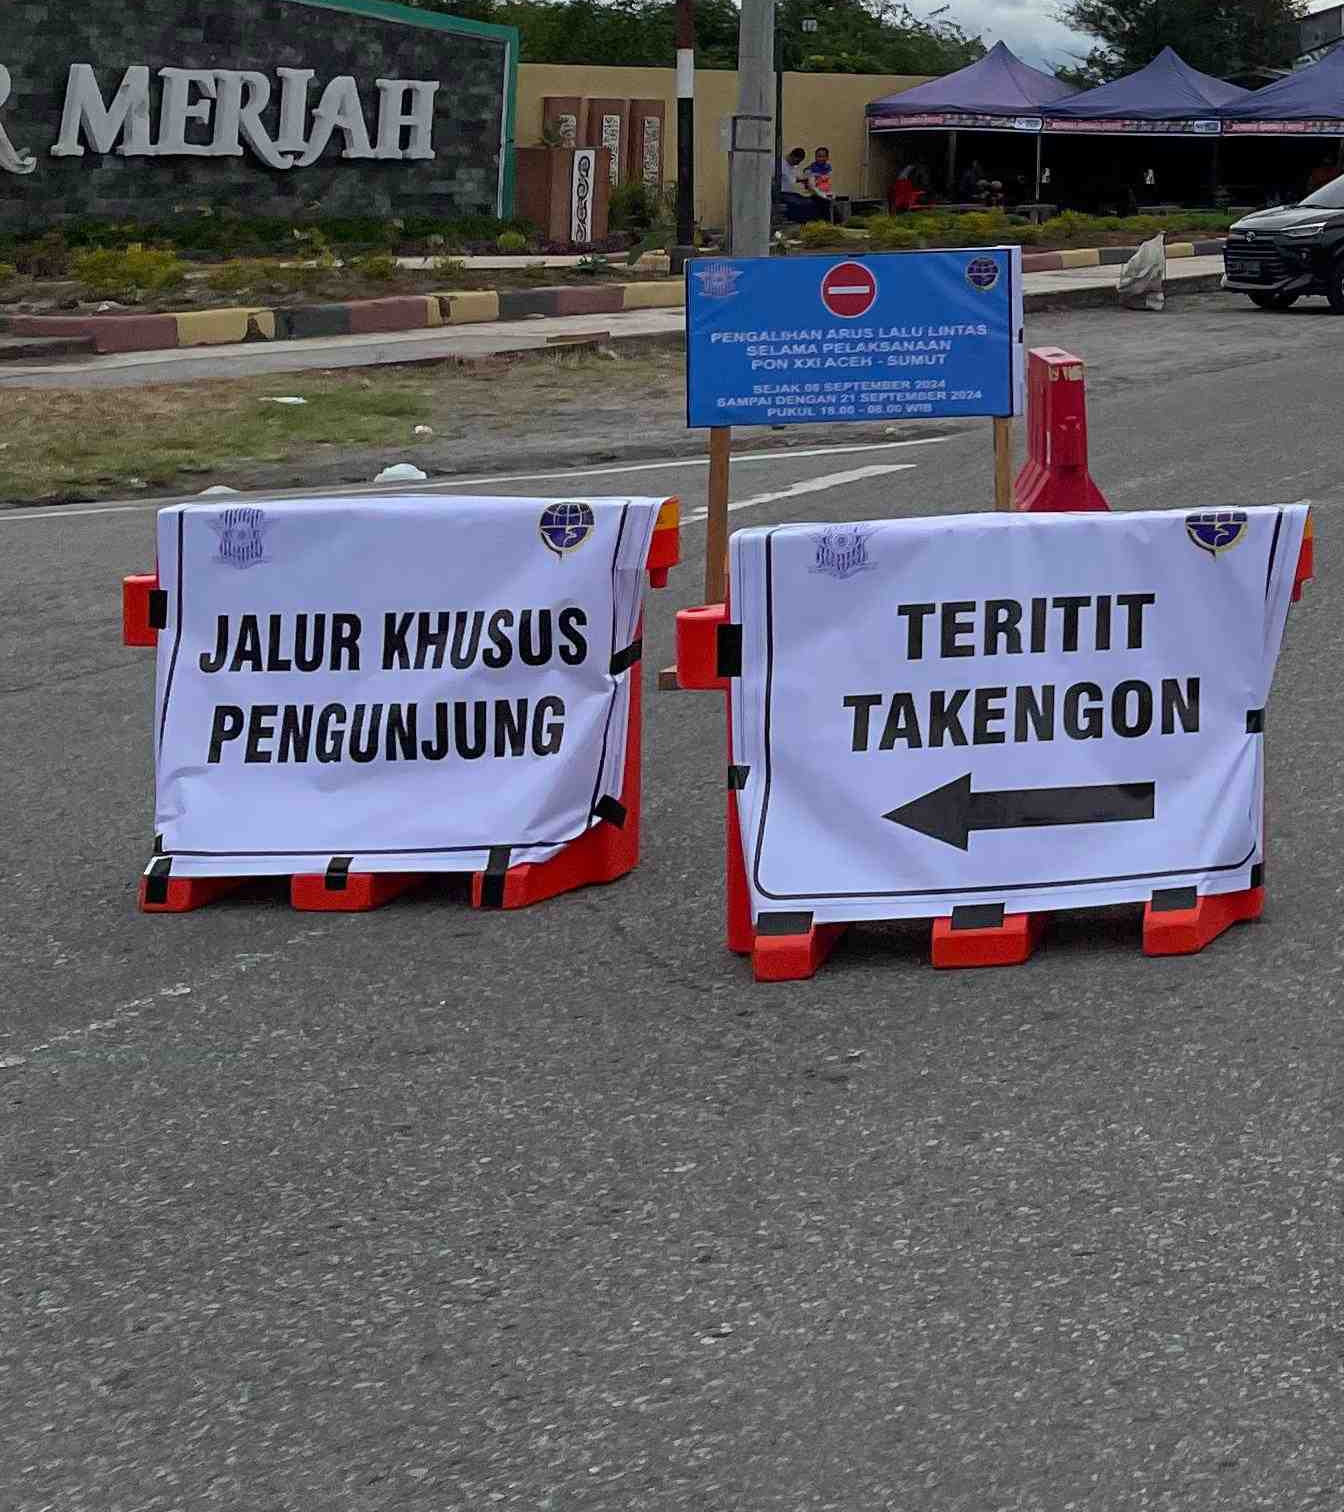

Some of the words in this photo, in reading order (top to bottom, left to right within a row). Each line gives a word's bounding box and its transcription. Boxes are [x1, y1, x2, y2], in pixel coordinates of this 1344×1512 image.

[50, 63, 440, 170] MERIAH
[711, 329, 822, 343] PENGALIHAN
[827, 327, 873, 339] ARUS
[879, 326, 922, 338] LALU
[928, 324, 988, 337] LINTAS
[746, 343, 818, 356] SELAMA
[823, 340, 952, 354] PELAKSANAAN
[752, 359, 788, 370] PON
[793, 357, 820, 368] XXI
[824, 356, 873, 368] ACEH
[887, 354, 947, 366] SUMUT
[753, 384, 801, 394] SEJAK
[823, 380, 912, 392] SEPTEMBER
[914, 379, 946, 389] 2024
[717, 396, 772, 407] SAMPAI
[775, 394, 836, 405] DENGAN
[840, 393, 855, 403] 21
[861, 391, 947, 402] SEPTEMBER
[951, 390, 983, 400] 2024
[767, 407, 816, 417] PUKUL
[897, 592, 1156, 660] TERITIT
[199, 612, 362, 673] JALUR
[381, 607, 588, 670] KHUSUS
[843, 677, 1201, 752] TAKENGON
[207, 695, 566, 764] PENGUNJUNG
